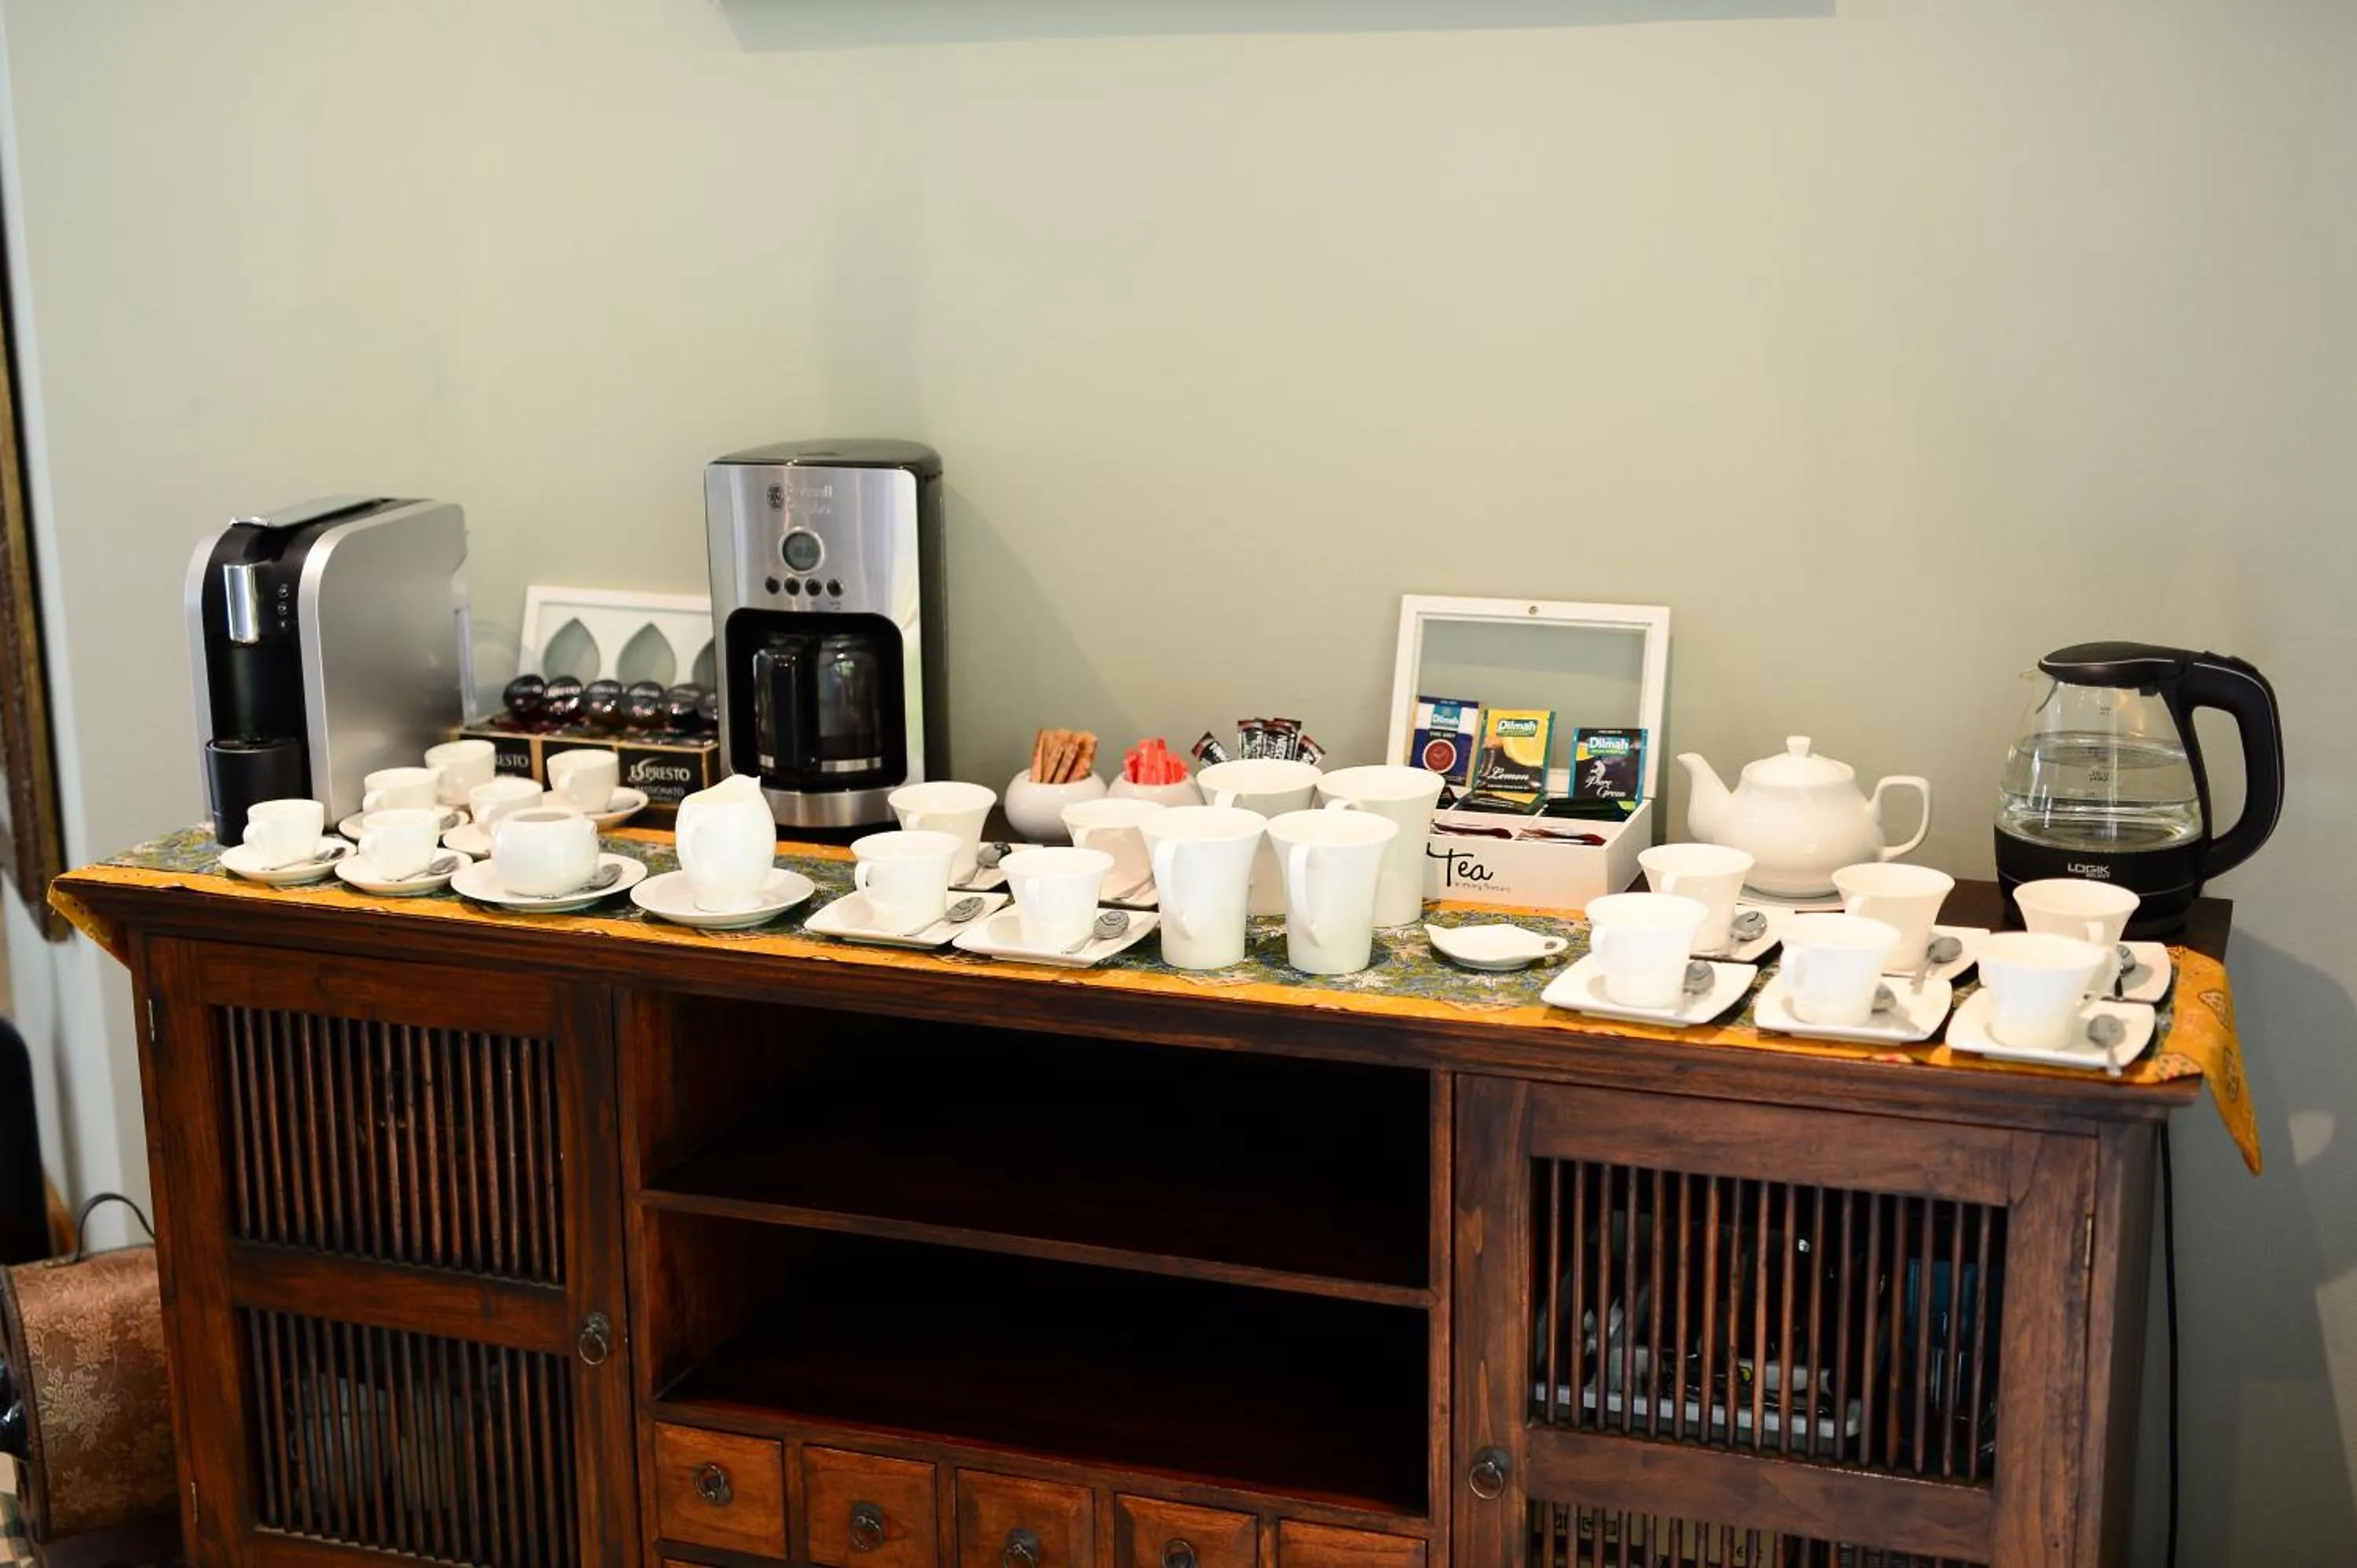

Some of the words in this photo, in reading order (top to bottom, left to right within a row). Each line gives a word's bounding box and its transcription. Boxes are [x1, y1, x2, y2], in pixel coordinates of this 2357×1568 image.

[1497, 720, 1538, 732] Dilmah
[1589, 737, 1629, 749] Dilmah
[1486, 767, 1530, 780] Lemon
[1426, 842, 1494, 887] Tea
[2067, 863, 2110, 874] LOGIK
